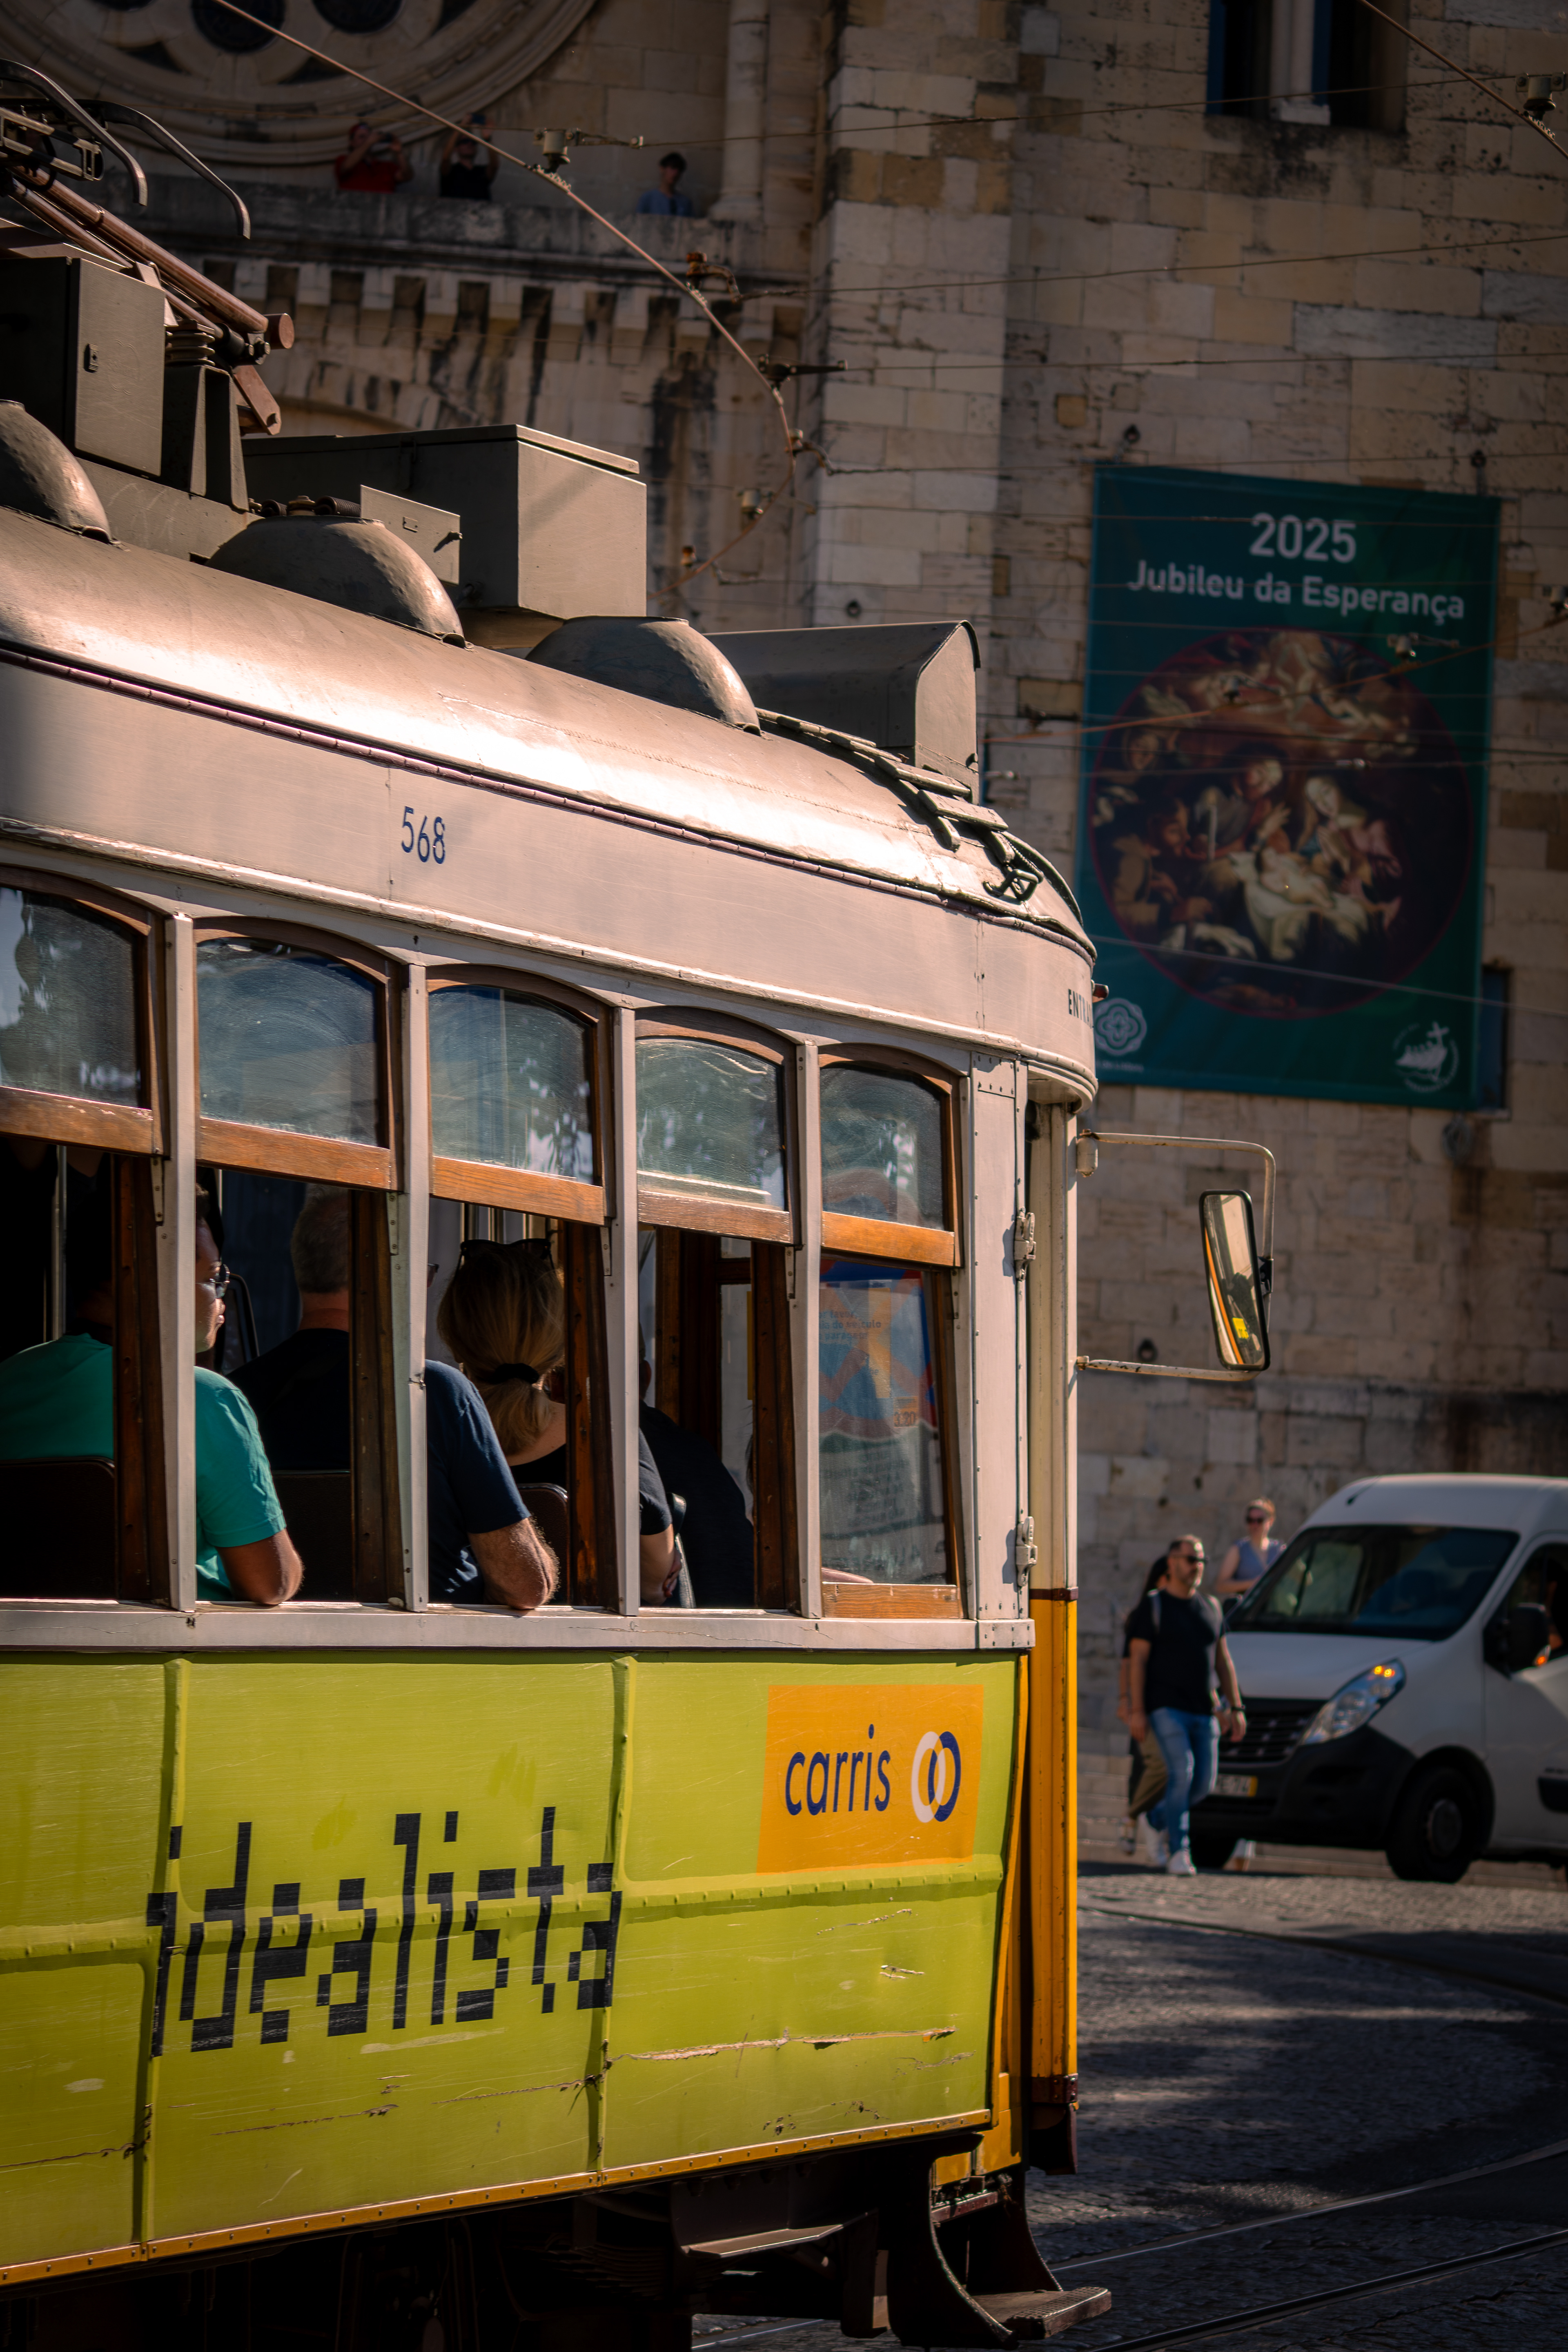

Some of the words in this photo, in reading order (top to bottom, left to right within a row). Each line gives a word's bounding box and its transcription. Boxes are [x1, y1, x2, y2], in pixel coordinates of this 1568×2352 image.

[1250, 512, 1356, 563] 2025
[1127, 559, 1243, 599] Jubileu
[1254, 572, 1291, 604] da
[1303, 575, 1464, 624] Esperança
[401, 806, 445, 864] 568
[785, 1724, 891, 1816] carris
[146, 1807, 623, 2058] idealista
